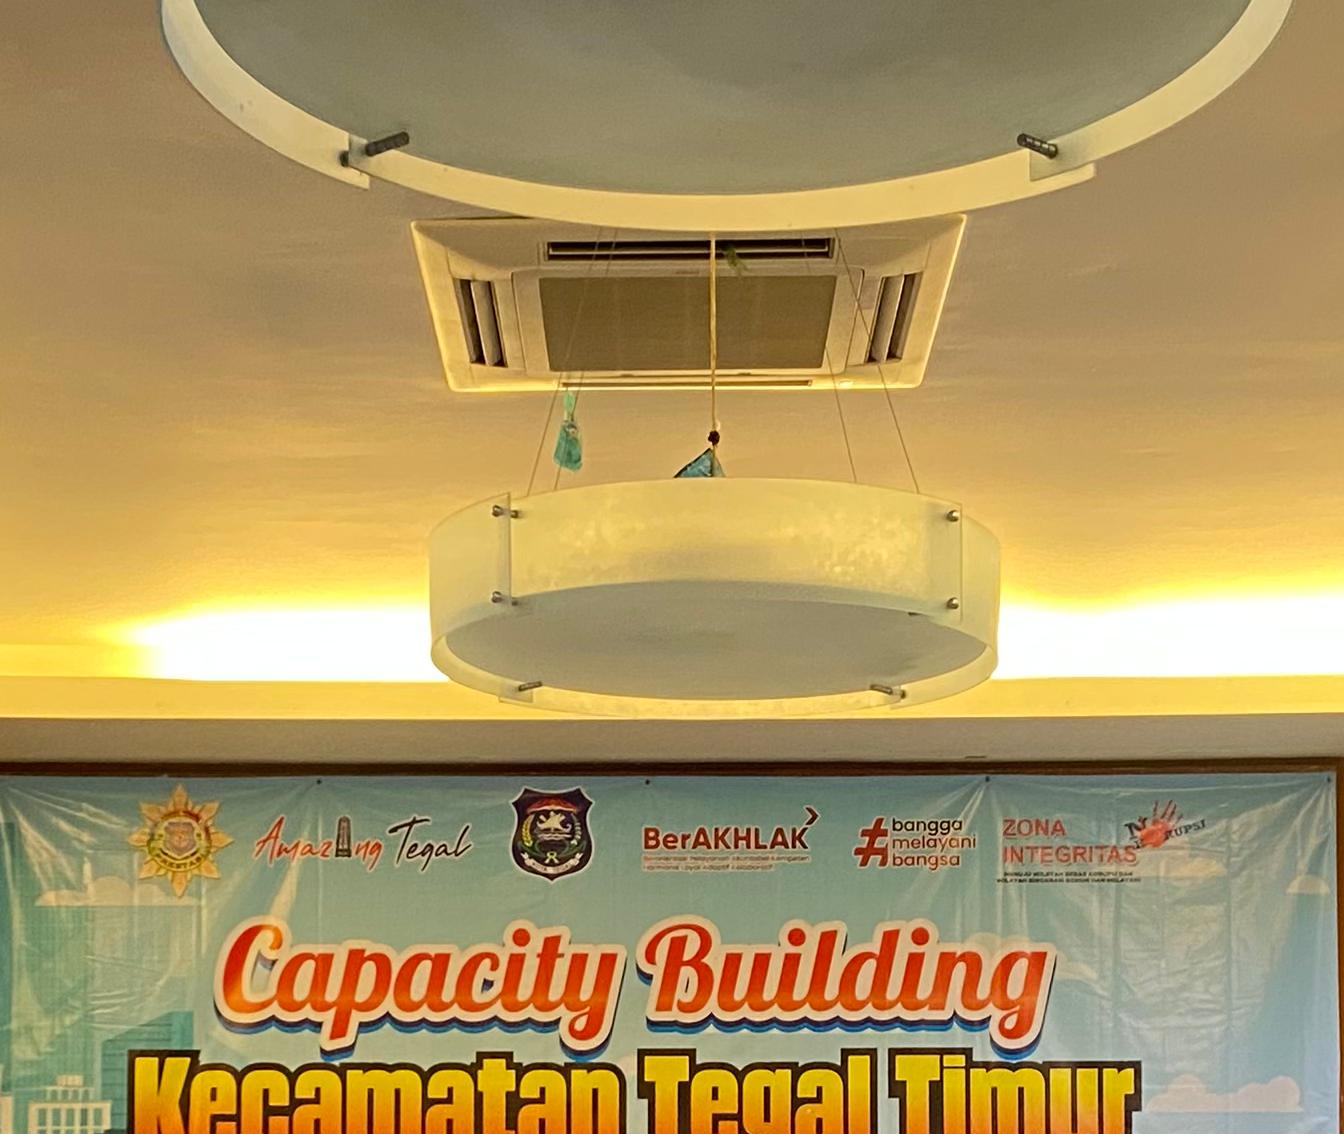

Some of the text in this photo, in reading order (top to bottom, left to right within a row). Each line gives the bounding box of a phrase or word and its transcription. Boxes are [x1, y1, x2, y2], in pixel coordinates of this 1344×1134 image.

[892, 817, 963, 836] bangga
[1003, 819, 1066, 837] ZONA
[389, 816, 472, 872] Tegal
[644, 827, 809, 850] BerAKHLAK
[892, 834, 976, 852] melayani
[892, 853, 961, 871] bangsa
[1003, 846, 1138, 864] INTEGRITAS
[219, 921, 1050, 1043] Capacity Building
